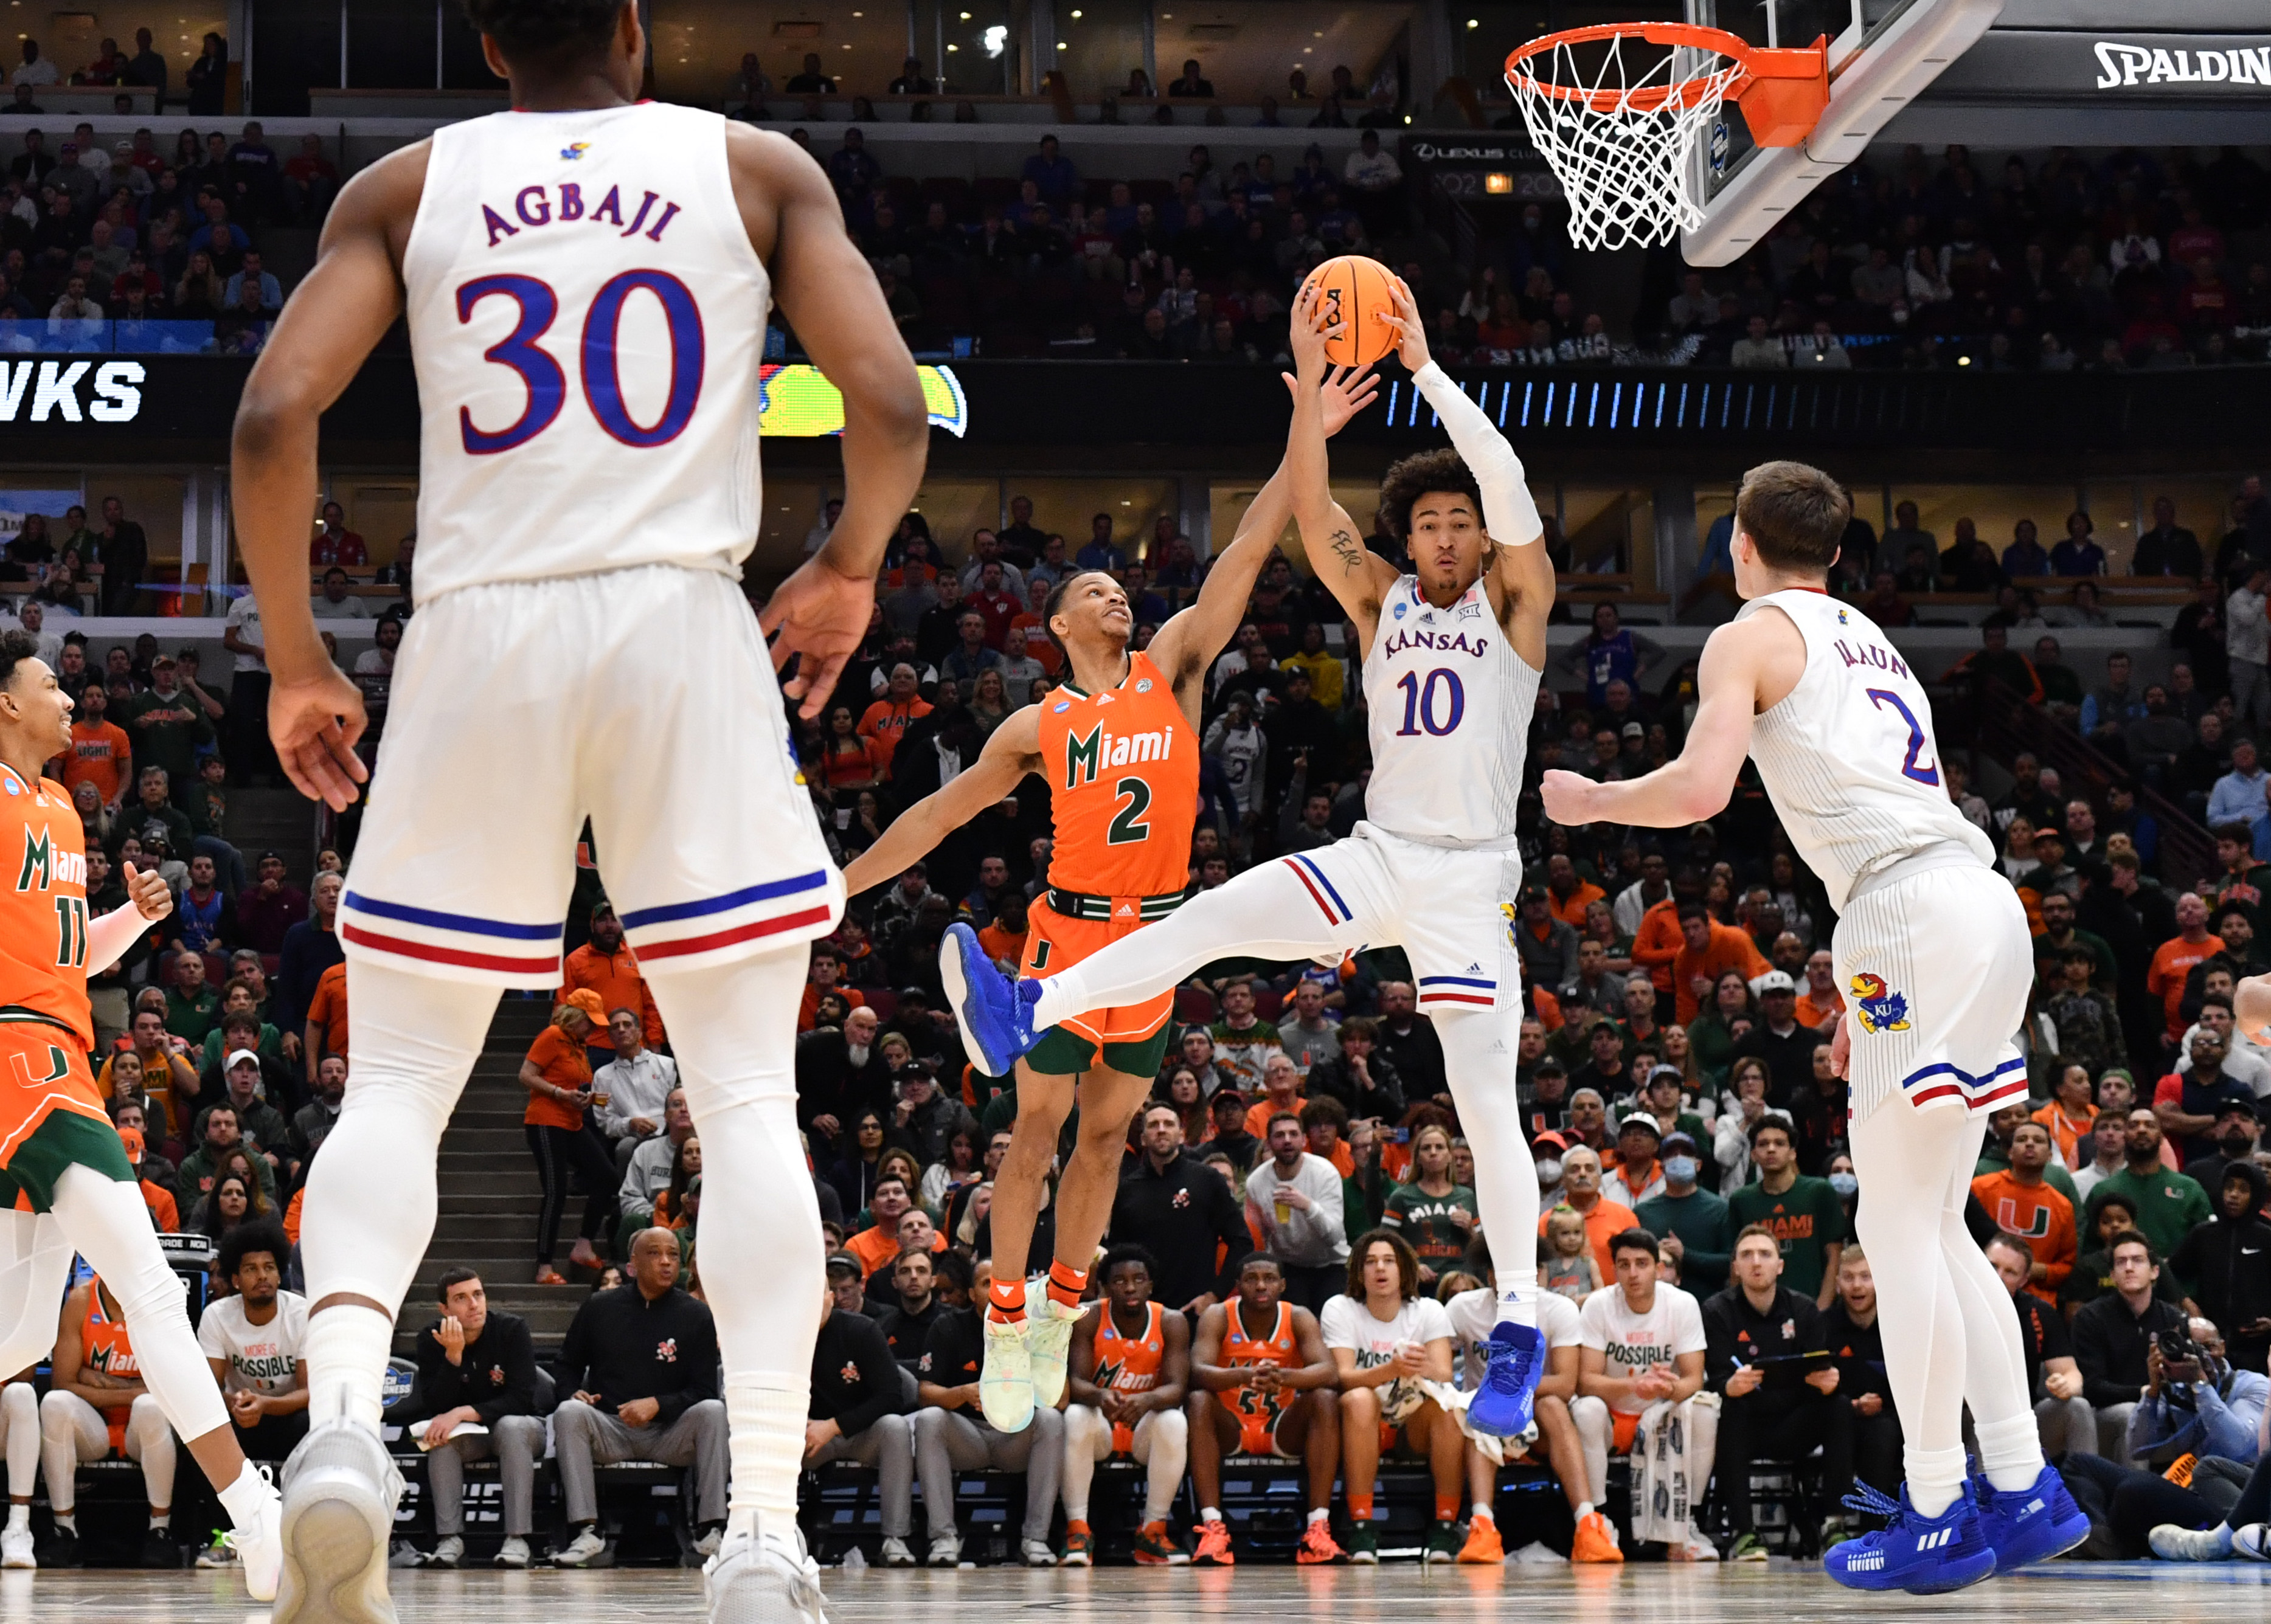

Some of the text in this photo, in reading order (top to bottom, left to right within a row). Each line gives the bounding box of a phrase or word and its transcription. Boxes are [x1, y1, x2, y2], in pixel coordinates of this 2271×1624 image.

[1438, 150, 1505, 159] LEXUS
[483, 182, 680, 246] AGBAJI
[457, 269, 704, 454] 30
[1328, 530, 1362, 577] FEAR
[1385, 629, 1488, 660] KANSAS
[1396, 668, 1464, 736] 10
[1067, 719, 1173, 789] Miami
[1865, 688, 1939, 787] 2
[1107, 776, 1151, 845] 2
[16, 822, 87, 892] Miam
[54, 895, 87, 967] 11
[1874, 1004, 1891, 1017] KU
[10, 1045, 69, 1088] U
[1996, 1197, 2050, 1239] U
[233, 1355, 296, 1378] POSSIBLE
[245, 1344, 265, 1357] MORE
[1606, 1341, 1672, 1364] POSSIBLE
